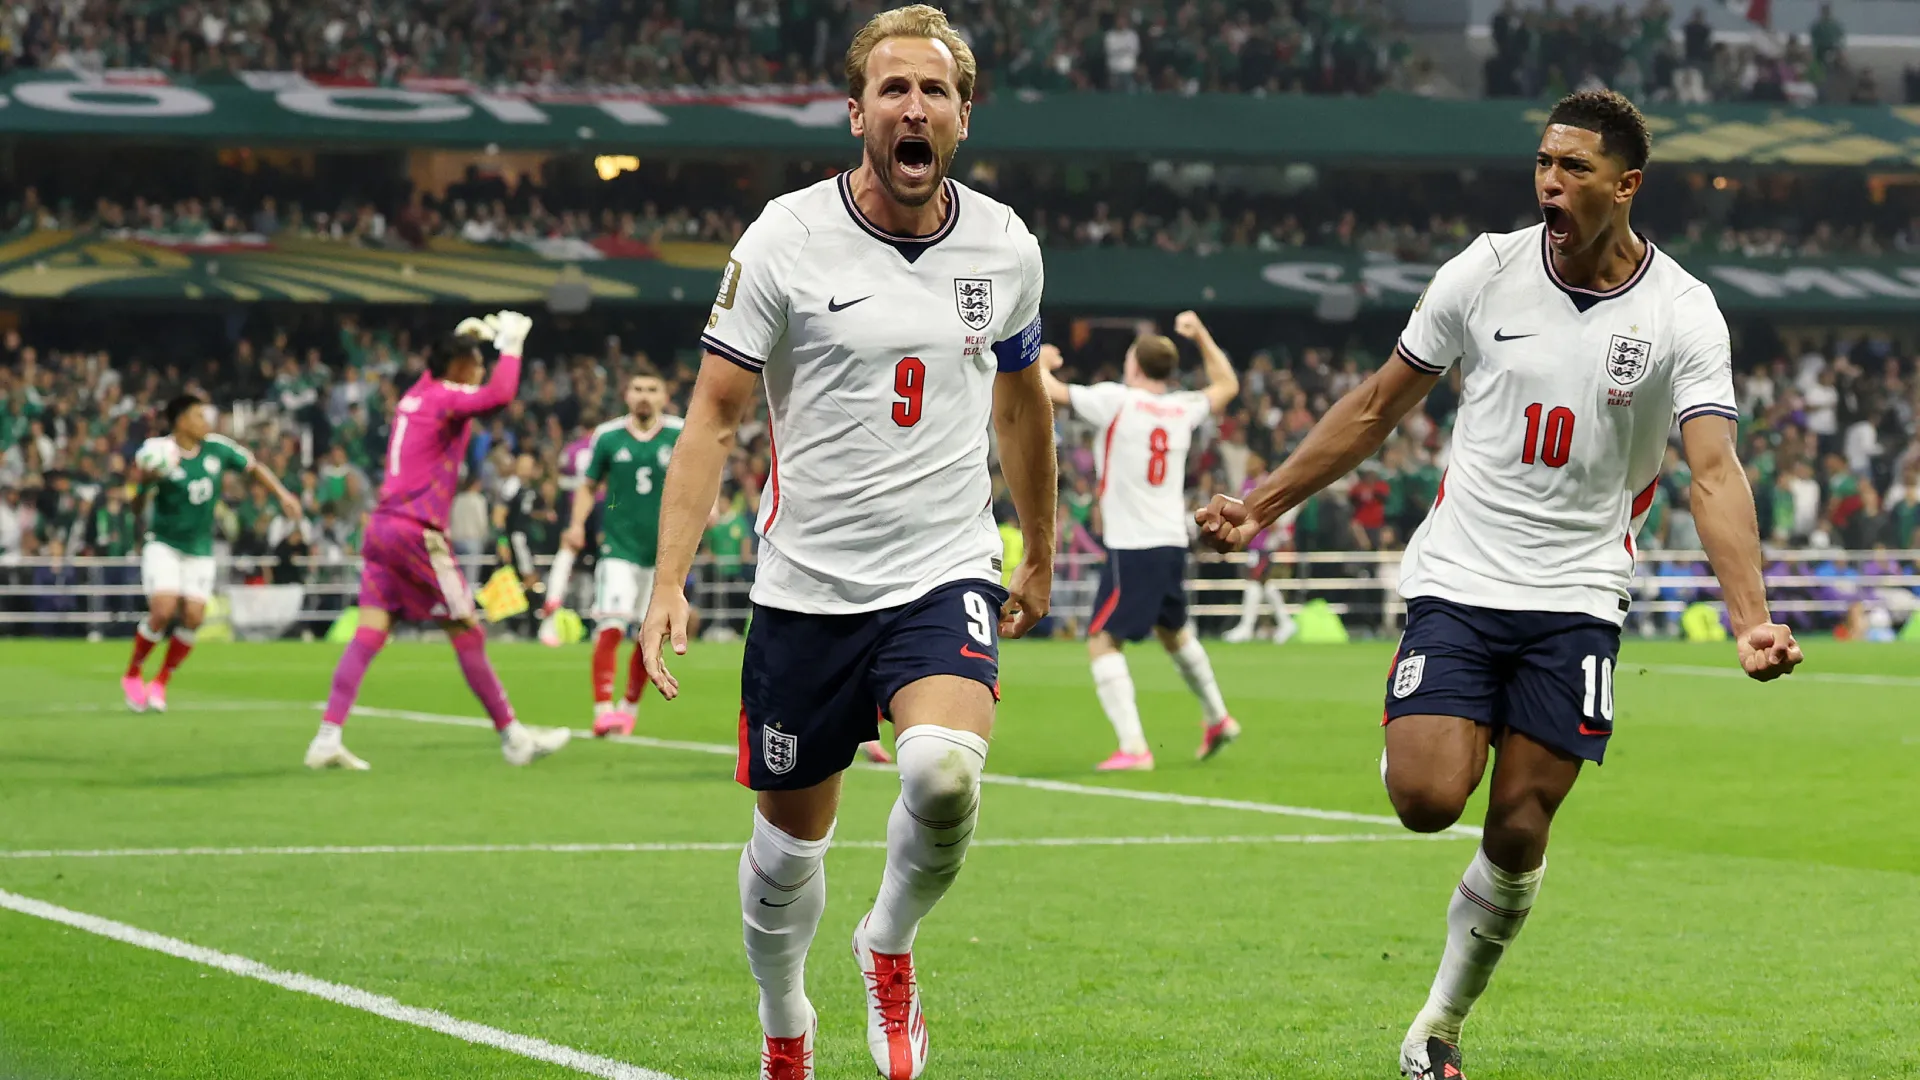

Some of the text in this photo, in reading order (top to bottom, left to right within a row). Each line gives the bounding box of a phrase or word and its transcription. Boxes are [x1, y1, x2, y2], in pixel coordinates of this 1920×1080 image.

[891, 357, 925, 427] 9
[1608, 388, 1634, 398] MEXICO
[390, 414, 408, 477] 1
[1147, 427, 1170, 487] 8
[1521, 402, 1575, 468] 10
[635, 466, 653, 495] 5
[963, 590, 993, 647] 9
[1581, 655, 1614, 721] 10
